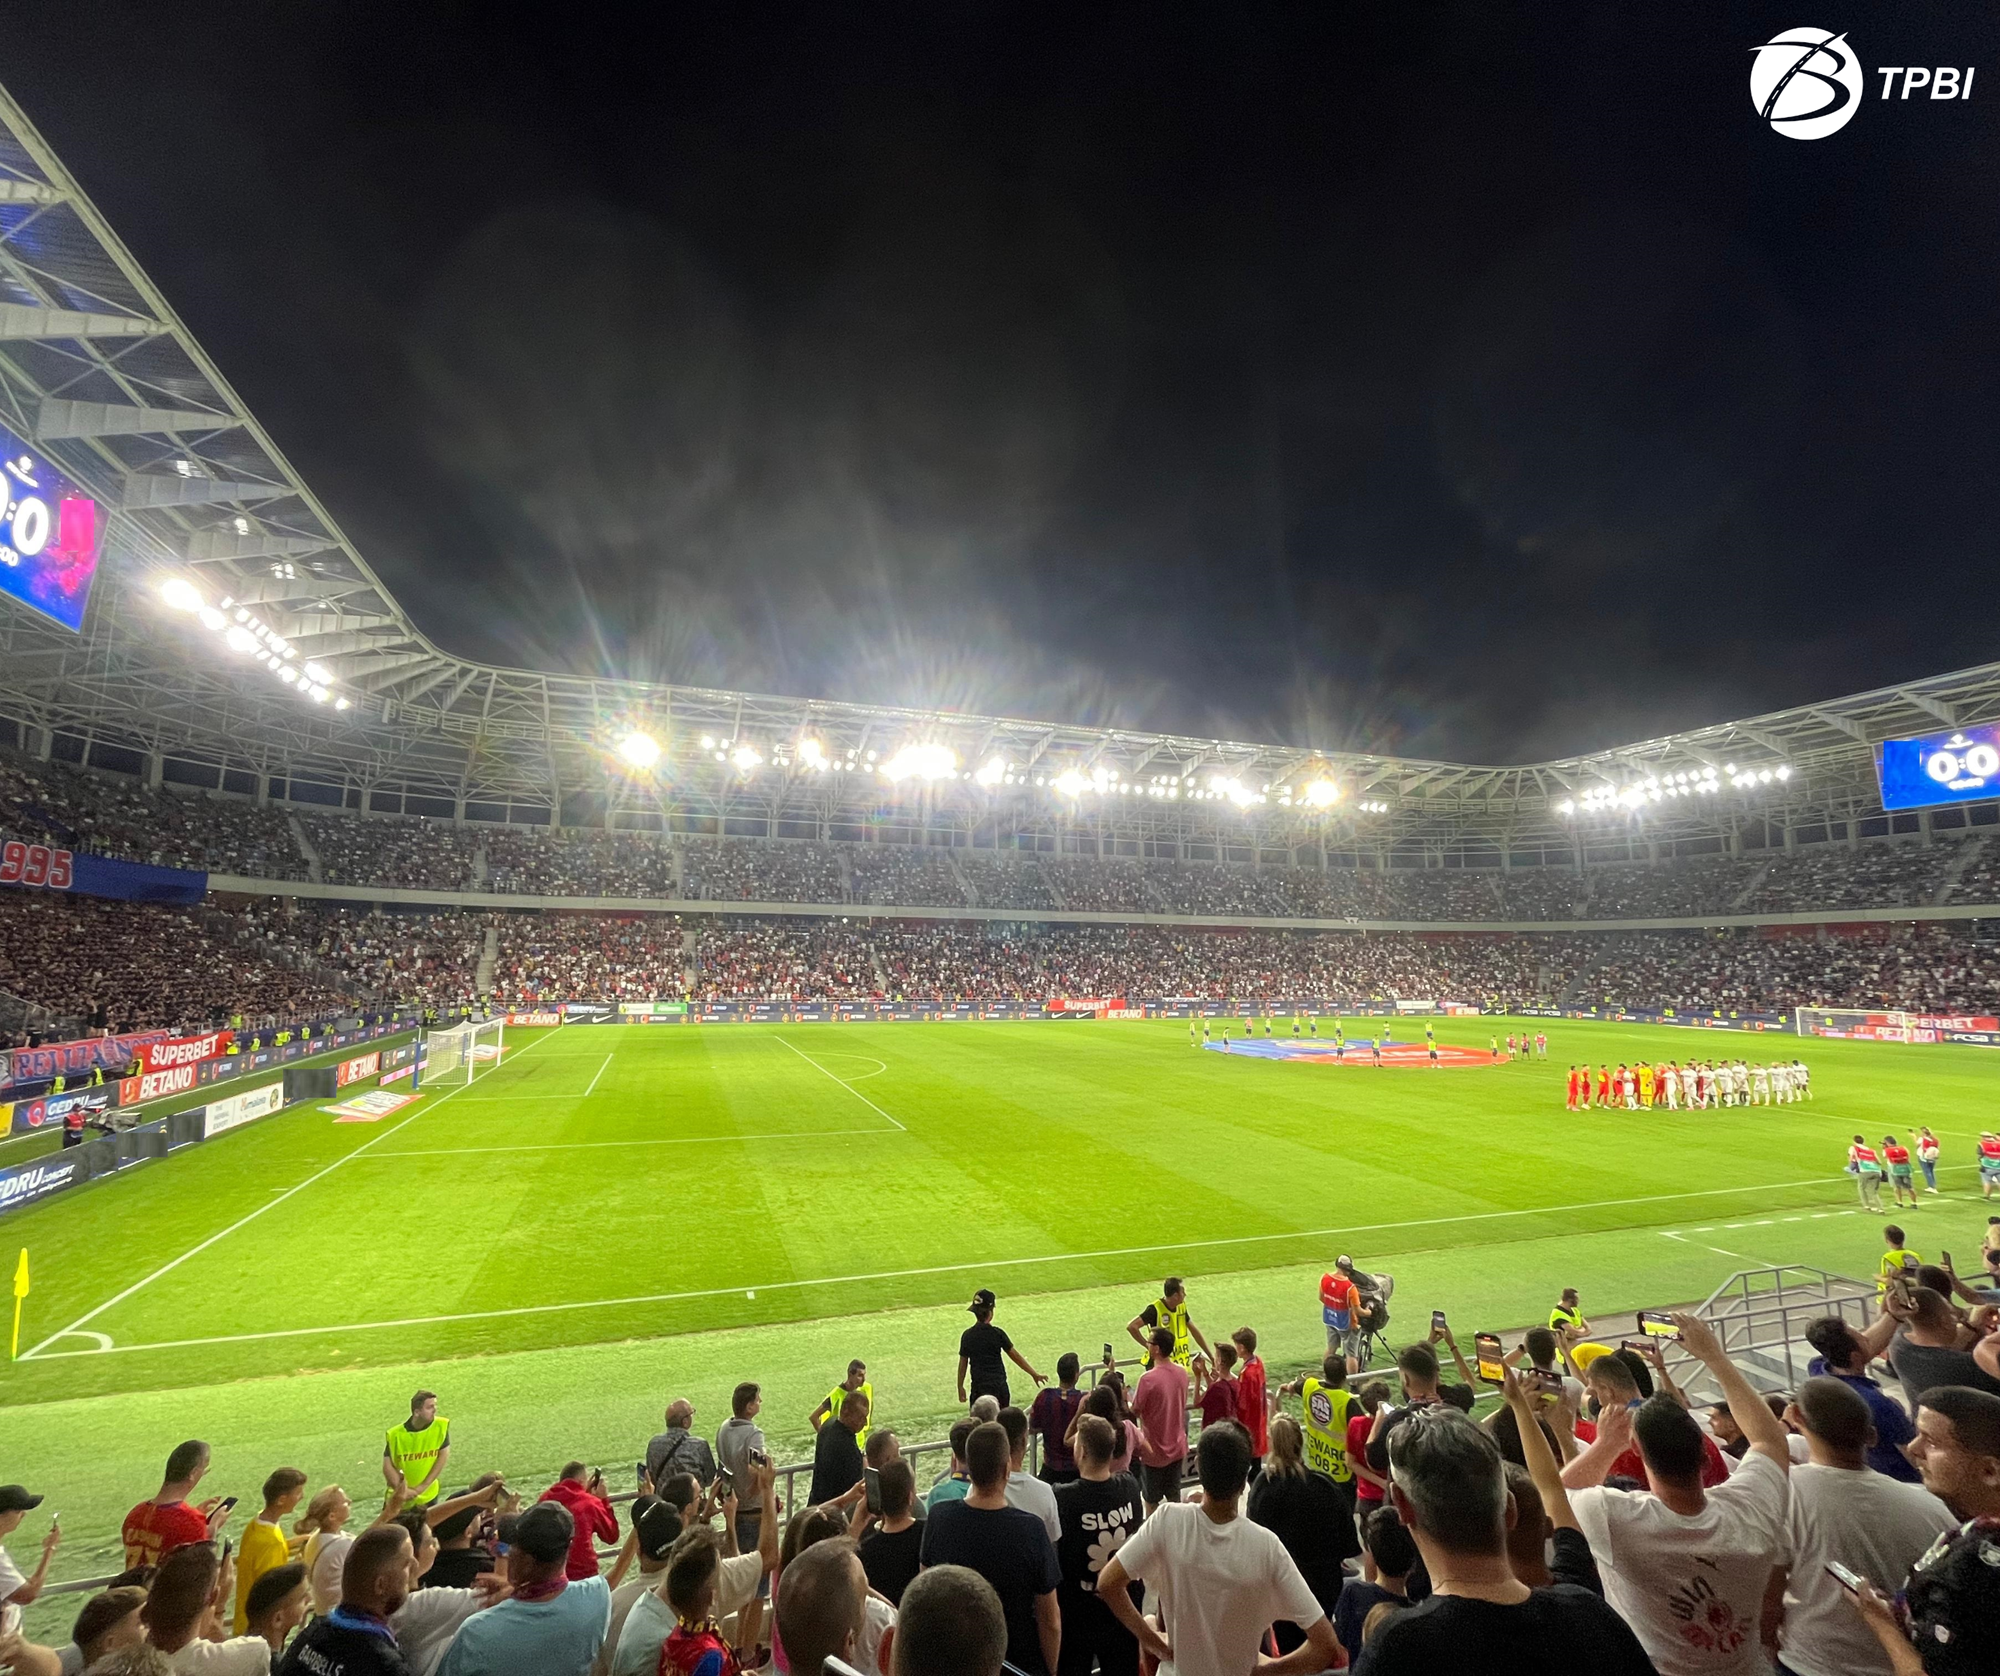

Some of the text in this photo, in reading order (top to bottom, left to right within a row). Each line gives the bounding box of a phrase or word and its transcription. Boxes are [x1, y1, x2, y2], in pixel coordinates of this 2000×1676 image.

[1064, 1000, 1111, 1010] SUPERBET
[1107, 1010, 1142, 1019] BETANO
[513, 1014, 559, 1025] BETANO
[150, 1034, 219, 1065] SUPERBET
[348, 1054, 377, 1083] BETANO
[140, 1066, 193, 1099] BETANO
[1311, 1396, 1330, 1415] SAS
[397, 1449, 439, 1461] STEWARD
[1081, 1502, 1133, 1530] SLOW
